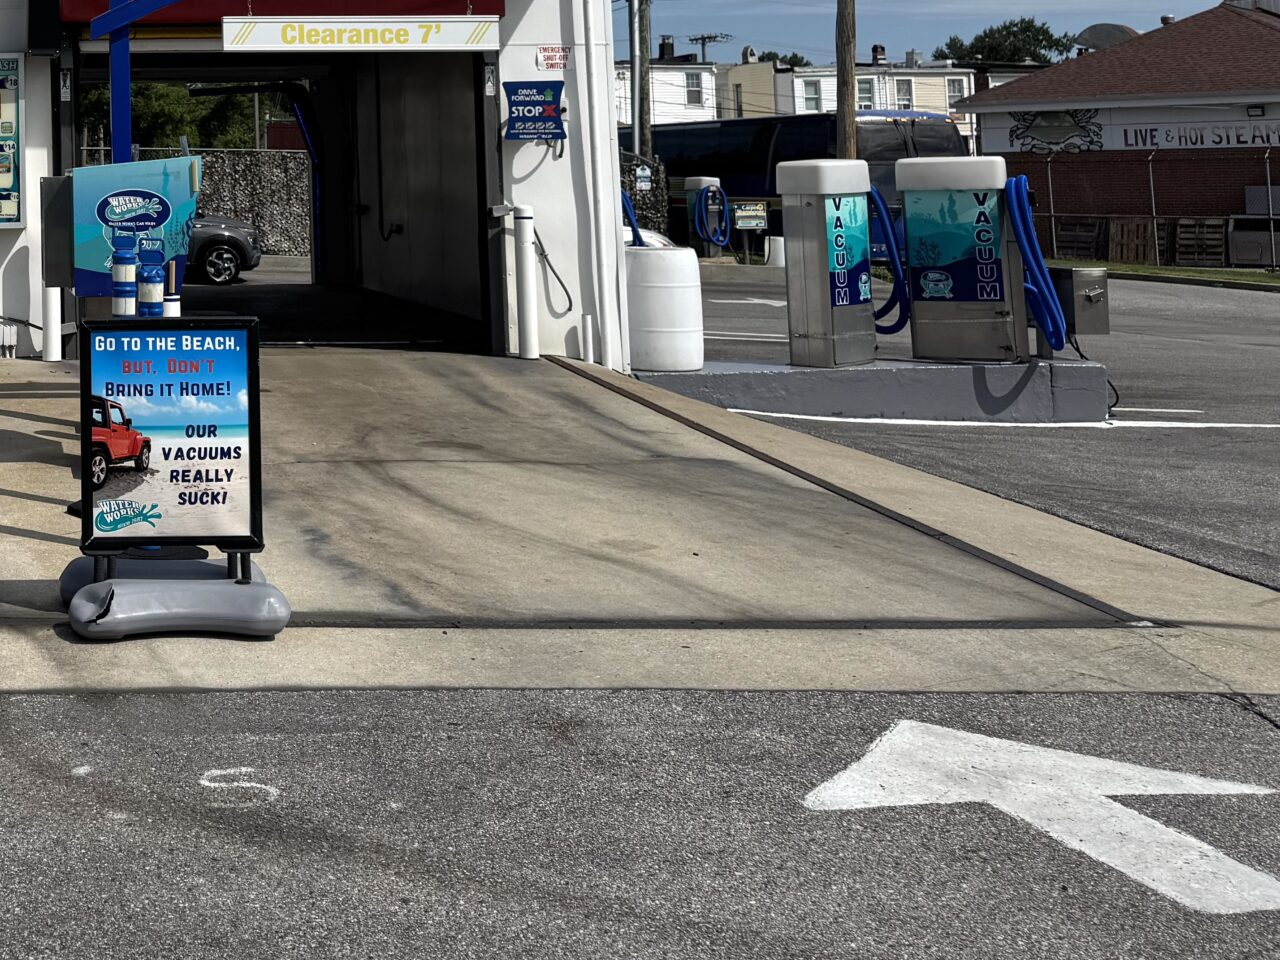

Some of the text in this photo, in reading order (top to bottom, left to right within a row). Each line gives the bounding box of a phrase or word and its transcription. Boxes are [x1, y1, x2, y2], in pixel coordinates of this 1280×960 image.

[280, 24, 441, 45] Clearance 7'
[512, 106, 543, 117] STOP
[1124, 128, 1158, 147] LIVE
[1165, 129, 1174, 142] &
[1178, 127, 1206, 146] HOT
[108, 196, 144, 206] WATER
[114, 202, 144, 214] WORKS
[832, 196, 850, 306] VACUUM
[972, 192, 1001, 300] VACUUM
[186, 424, 218, 438] OUR
[162, 446, 242, 460] VACUUMS
[170, 468, 234, 483] REALLY
[97, 500, 140, 514] WATER
[104, 508, 140, 523] WORKS
